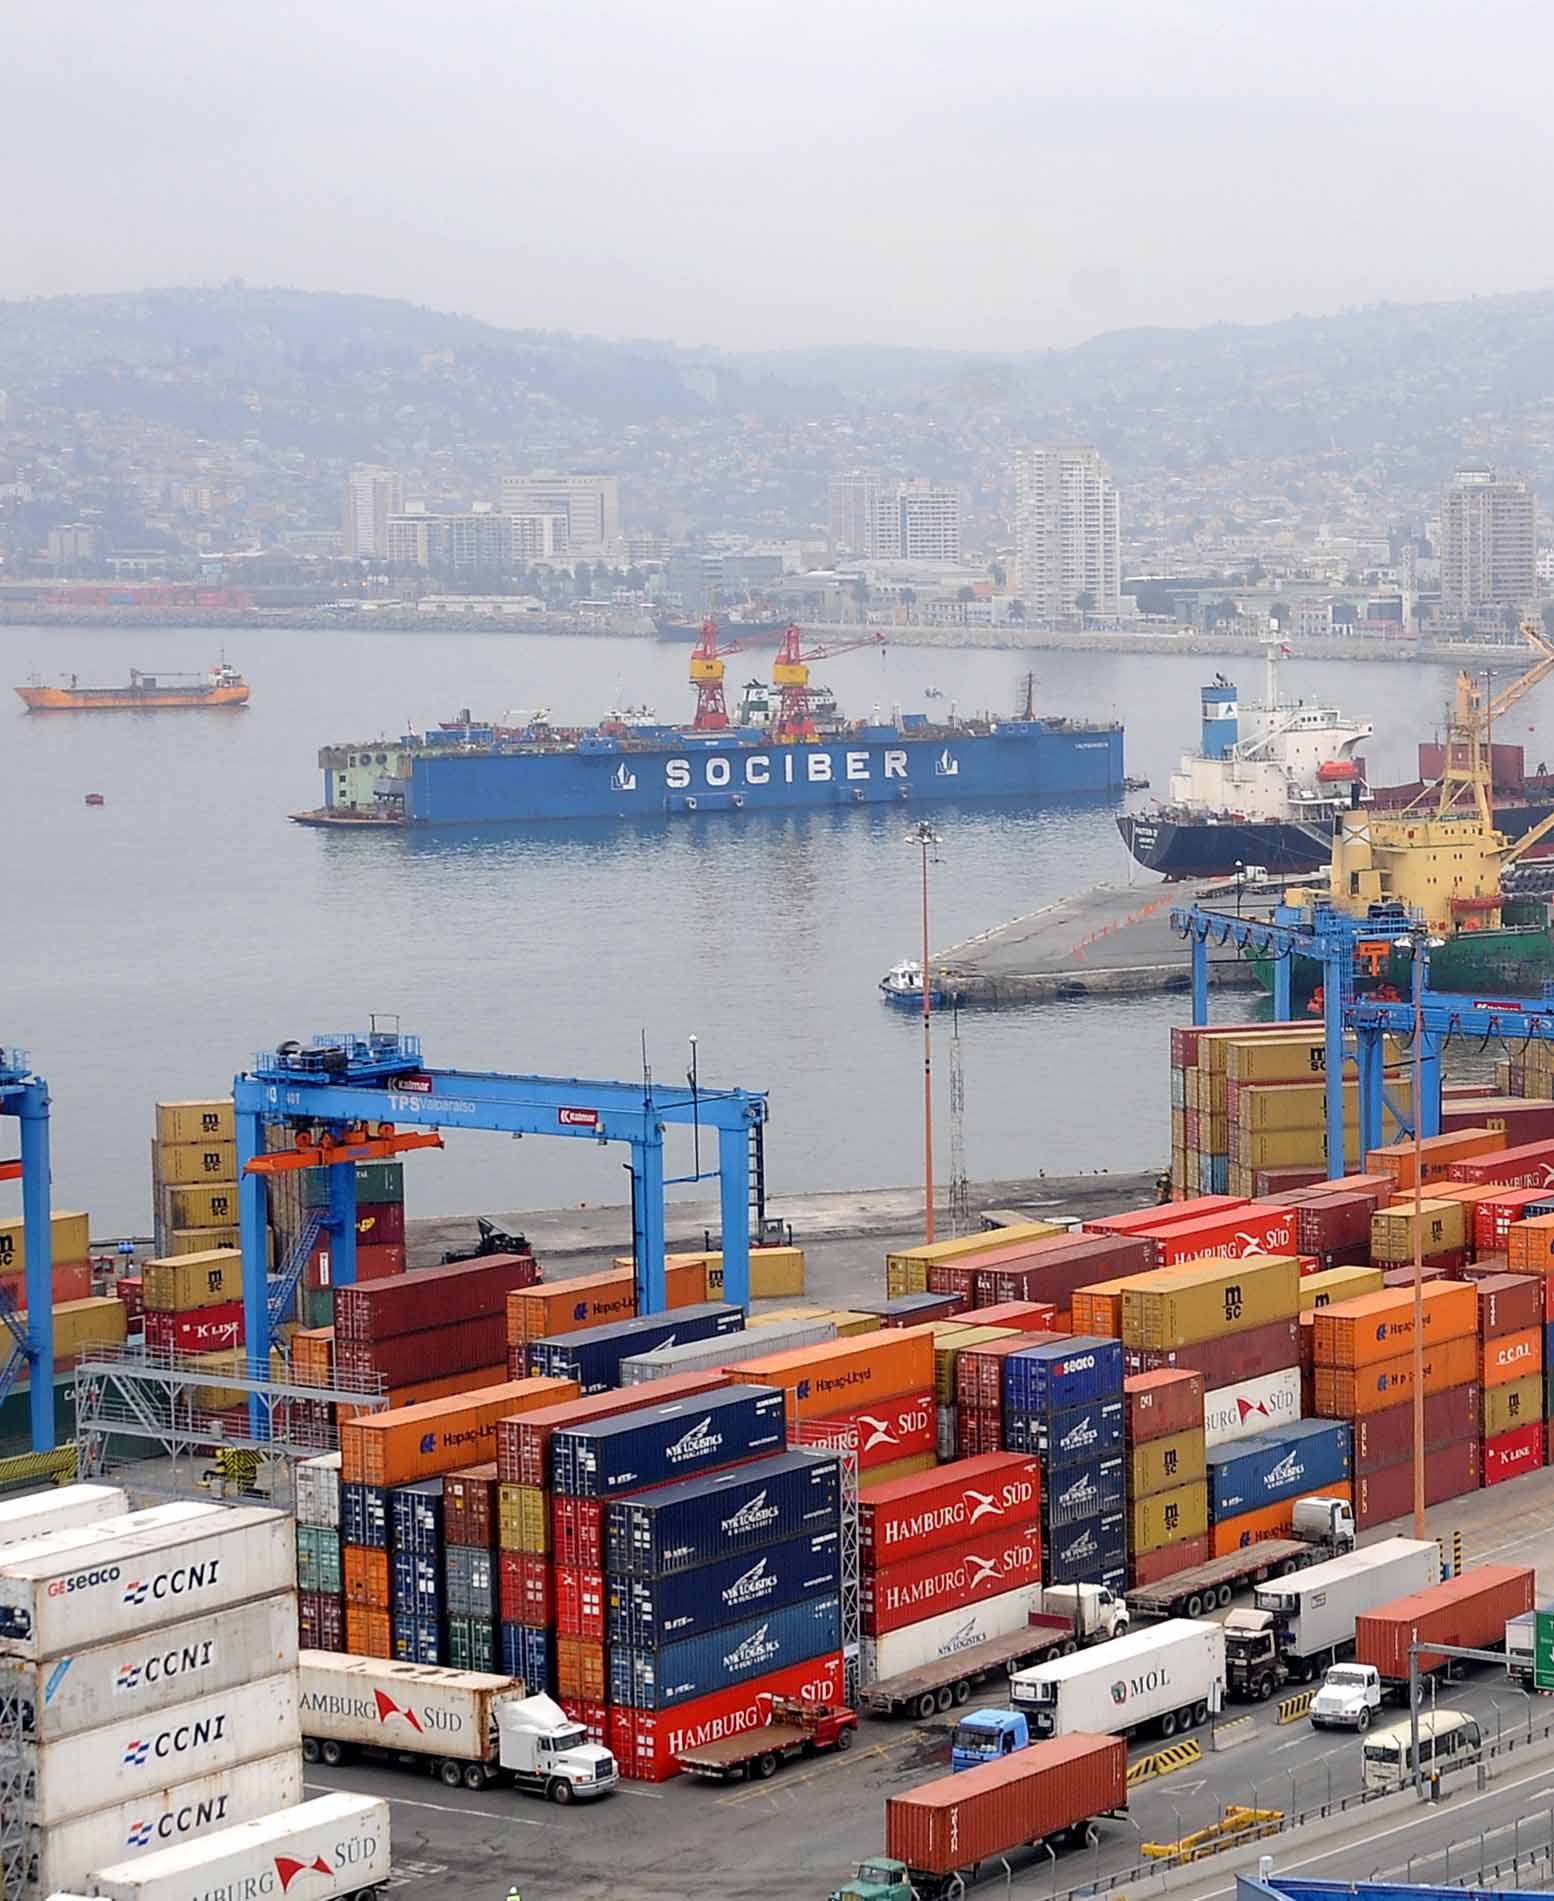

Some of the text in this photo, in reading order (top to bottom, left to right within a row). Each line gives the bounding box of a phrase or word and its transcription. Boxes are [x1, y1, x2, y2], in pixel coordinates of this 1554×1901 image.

[664, 748, 909, 788] SOCIBER
[1266, 1229, 1290, 1249] SÜD
[1268, 1389, 1294, 1411] SÜD
[898, 1411, 927, 1434] SÜD
[884, 1501, 965, 1544] HAMBURG
[1002, 1481, 1033, 1508] SÜD
[152, 1560, 220, 1599] CCNI
[886, 1566, 966, 1611] HAMBURG
[1002, 1545, 1034, 1571] SÜD
[145, 1641, 213, 1682] CCNI
[1130, 1668, 1171, 1698] MOL
[154, 1714, 226, 1759] CCNI
[423, 1702, 463, 1734] SÜD
[668, 1679, 834, 1756] HAMBURG SÜD
[157, 1794, 229, 1839] CCNI
[334, 1836, 378, 1868] SÜD
